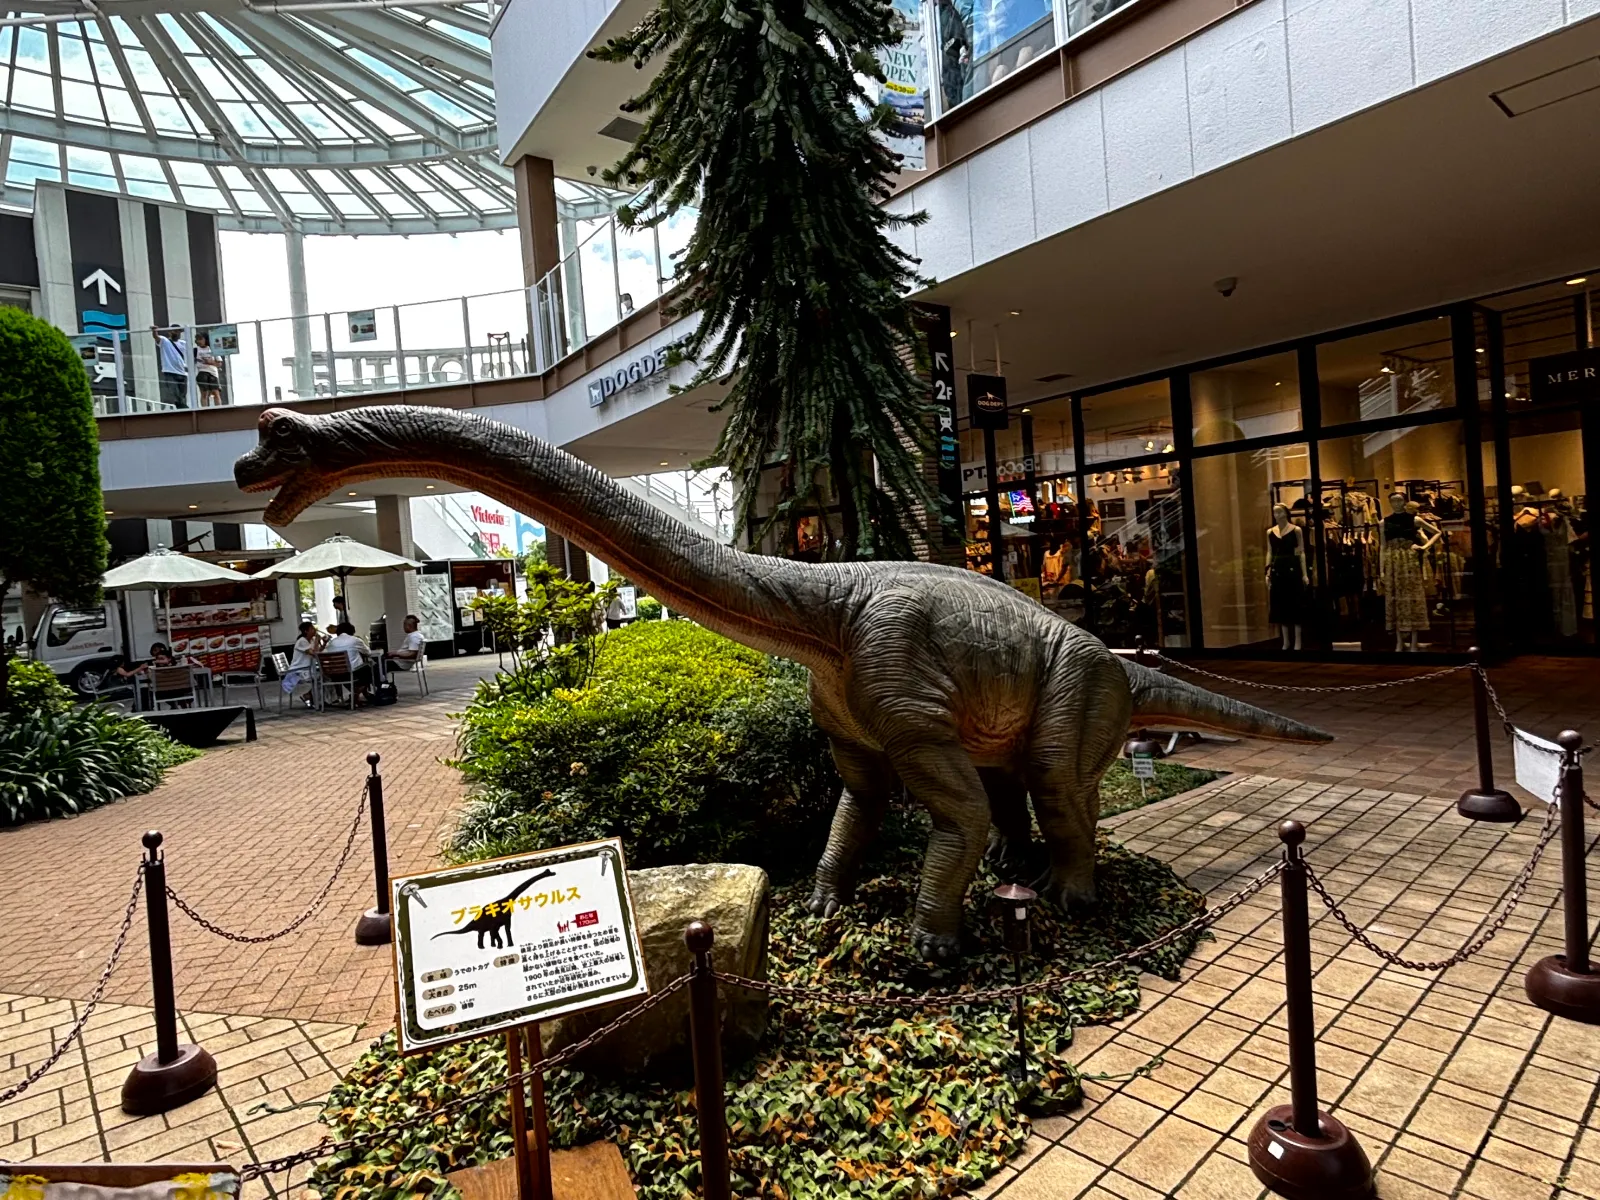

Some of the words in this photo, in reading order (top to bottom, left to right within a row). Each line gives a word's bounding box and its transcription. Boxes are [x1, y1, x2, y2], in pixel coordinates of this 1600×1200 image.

[885, 49, 917, 68] NEW
[881, 63, 917, 83] OPEN
[1548, 367, 1596, 384] MER
[935, 380, 953, 400] 2F
[470, 505, 504, 525] Victoria
[451, 886, 581, 924] ブラキオサウルス
[429, 989, 448, 1000] 大きさ
[458, 982, 477, 992] 25m
[427, 1005, 454, 1017] たべもの
